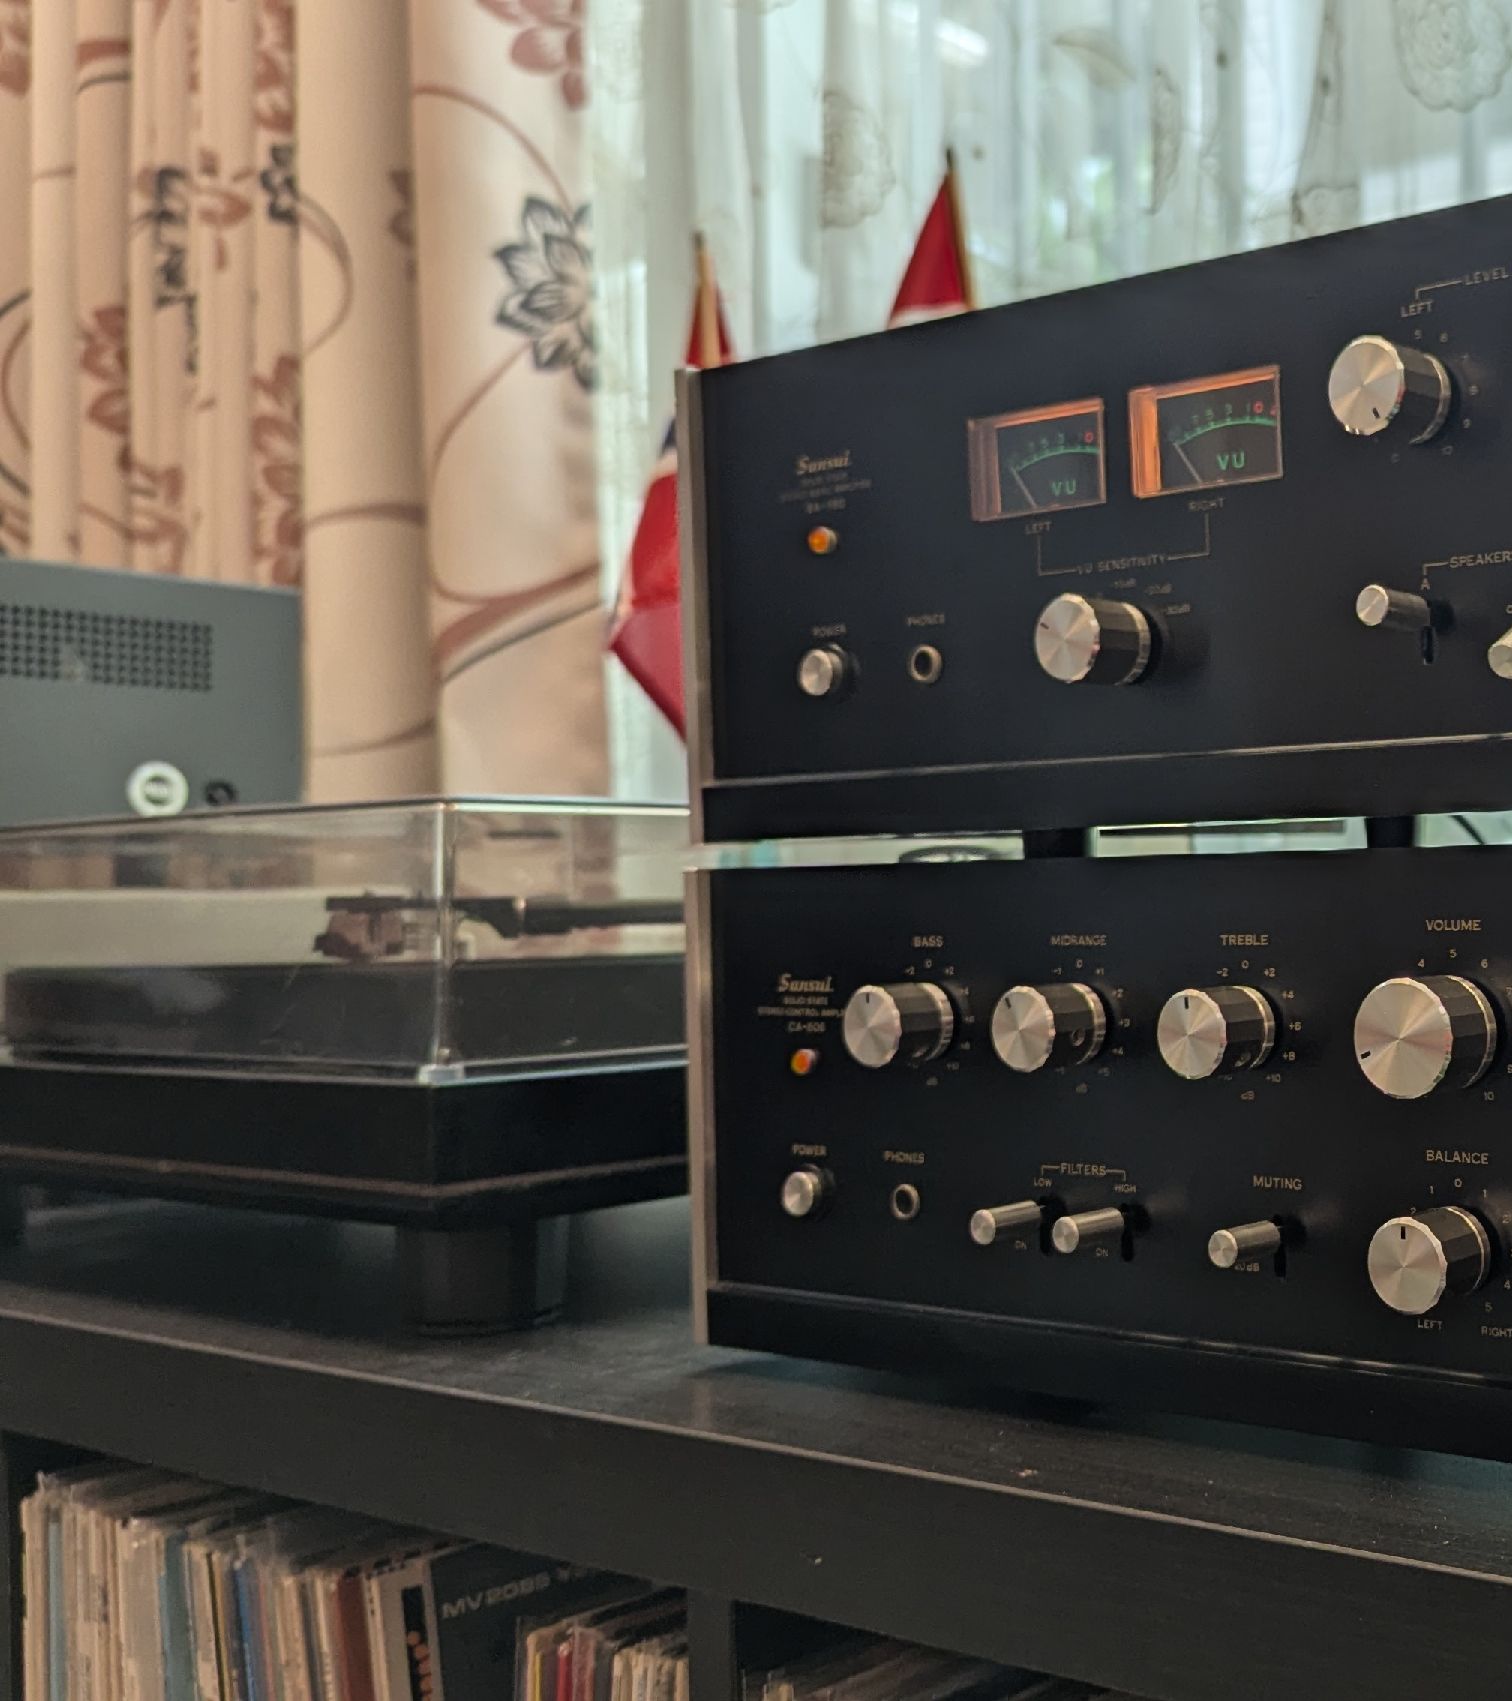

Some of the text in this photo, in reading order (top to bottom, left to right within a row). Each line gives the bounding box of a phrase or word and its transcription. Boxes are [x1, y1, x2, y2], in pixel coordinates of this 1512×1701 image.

[1464, 267, 1510, 286] LEVEL
[1400, 300, 1434, 318] LEFT
[1217, 450, 1245, 471] VU
[1051, 479, 1077, 497] VU
[1097, 553, 1166, 573] SENSITIVITY
[1421, 577, 1431, 590] A
[1425, 919, 1482, 931] VOLUME
[912, 935, 945, 948] BASS
[1050, 935, 1107, 946] MIDRANGE
[1220, 934, 1269, 946] TREBLE
[1449, 949, 1457, 958] 5
[1075, 958, 1084, 968] 0
[1240, 959, 1250, 970] 0
[1417, 958, 1425, 968] 4
[1480, 958, 1489, 969] 6
[1216, 966, 1230, 978] -2
[1263, 967, 1276, 978] +2
[1289, 1021, 1302, 1031] +6
[1282, 1051, 1296, 1061] +8
[791, 1143, 827, 1156] POWER
[1426, 1149, 1489, 1165] BALANCE
[1060, 1163, 1107, 1176] FILTERS
[1252, 1174, 1302, 1191] MUTING
[1453, 1178, 1462, 1188] 0
[1113, 1184, 1137, 1193] HIGH
[1502, 1214, 1511, 1224] 2
[1095, 1247, 1109, 1257] ON
[1504, 1279, 1511, 1290] 4
[1485, 1301, 1493, 1312] 5
[1417, 1318, 1443, 1330] LEFT
